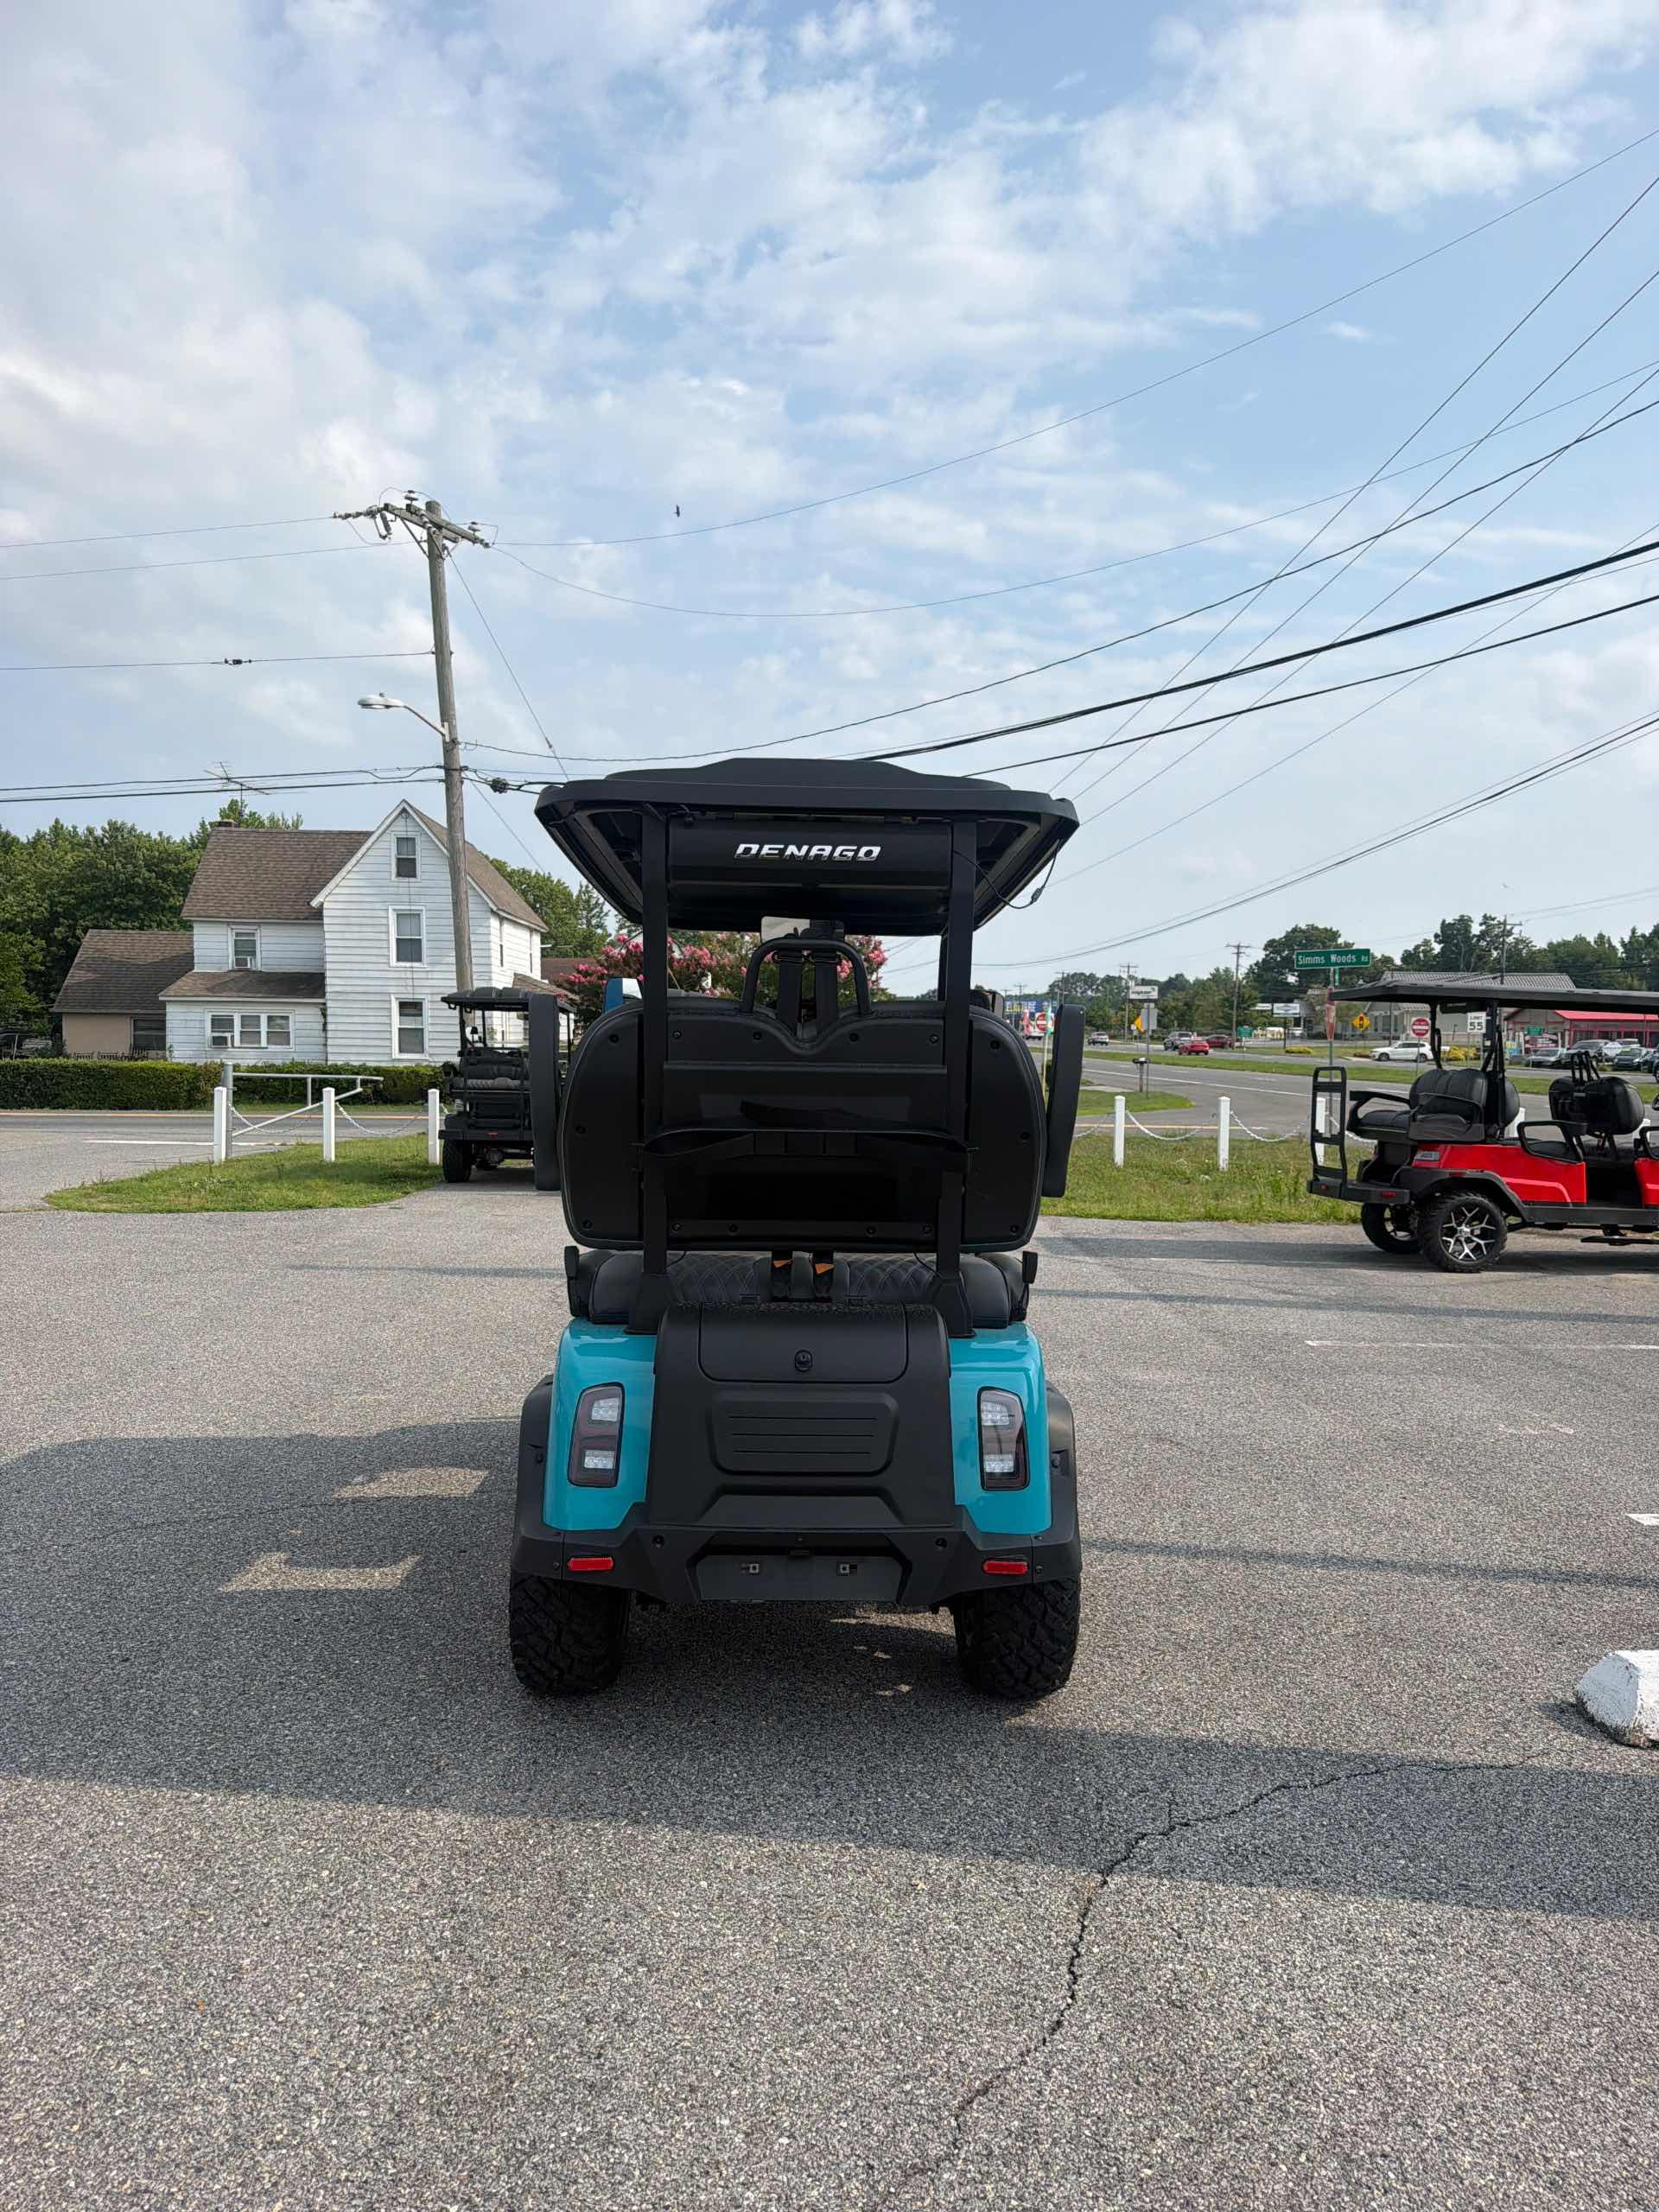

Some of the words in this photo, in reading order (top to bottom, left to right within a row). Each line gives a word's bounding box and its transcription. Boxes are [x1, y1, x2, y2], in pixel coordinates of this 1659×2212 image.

[734, 843, 881, 861] DENAGO
[1298, 955, 1325, 965] Simms
[1331, 953, 1357, 963] Woods
[1469, 1021, 1484, 1031] 55
